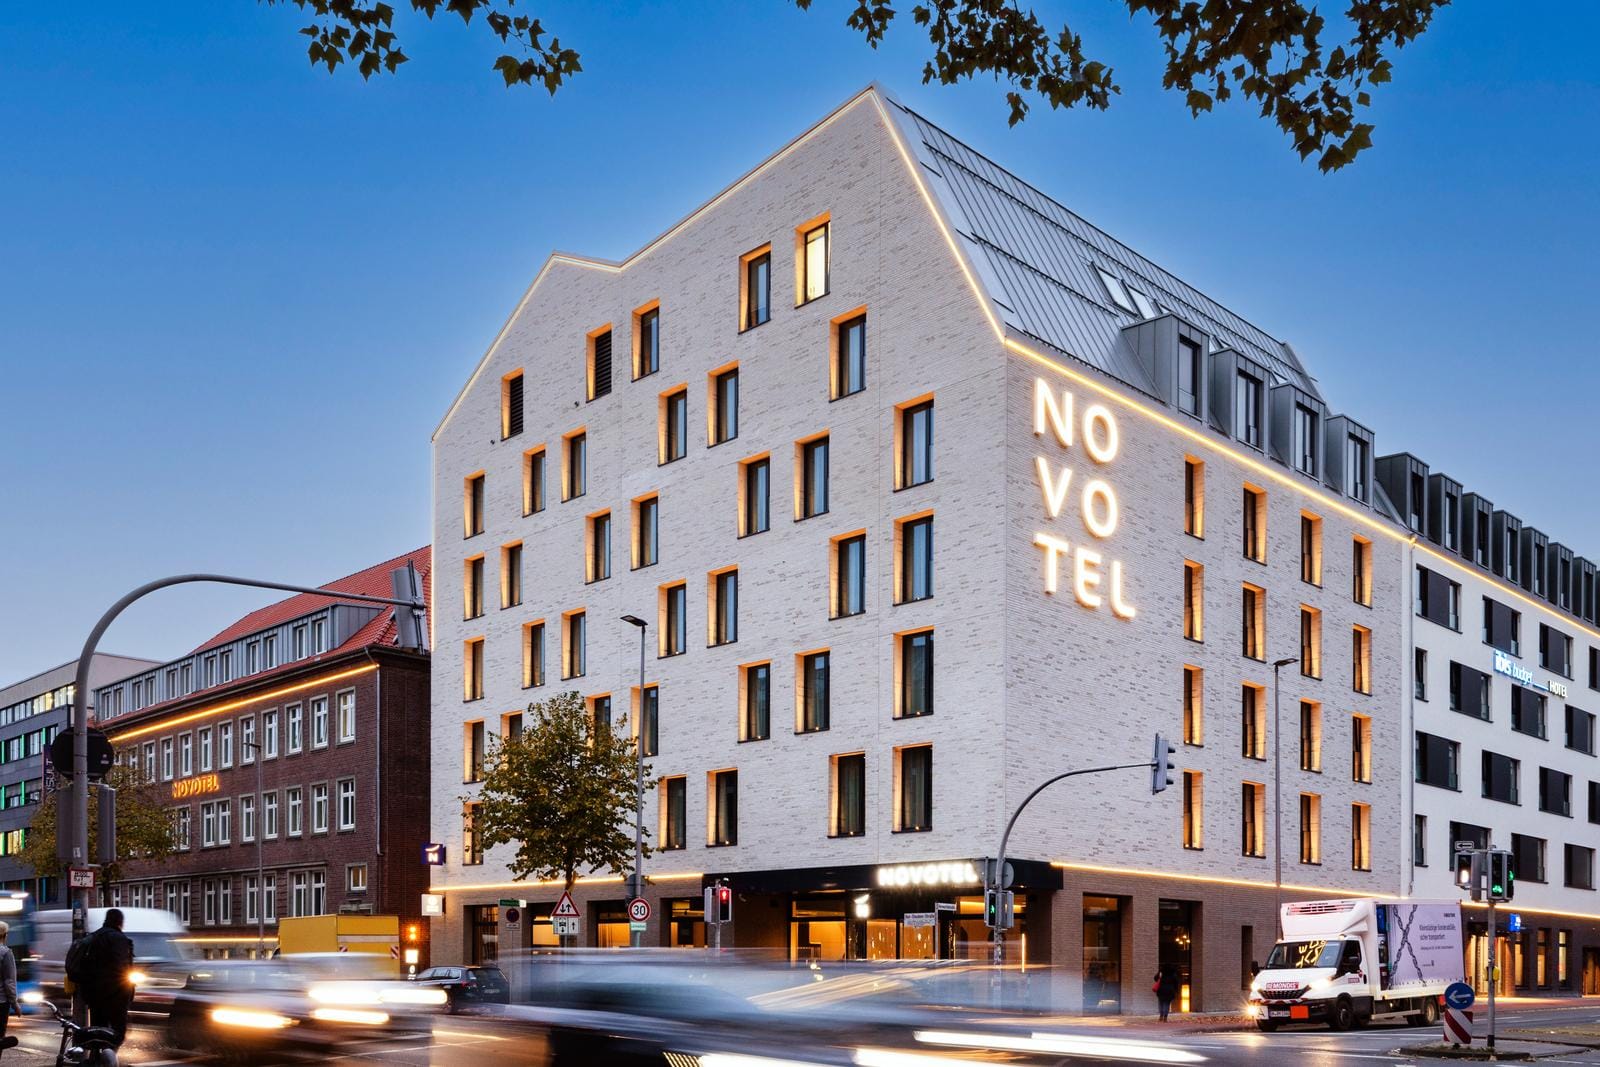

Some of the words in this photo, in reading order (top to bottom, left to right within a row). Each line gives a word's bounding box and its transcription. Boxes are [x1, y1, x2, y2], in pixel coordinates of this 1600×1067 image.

[1033, 532, 1136, 620] TEL
[1512, 662, 1533, 685] budget
[1548, 680, 1568, 698] HOTEL
[171, 774, 219, 799] NOVOTEL
[877, 861, 978, 887] NOVOTEL
[633, 905, 646, 916] 30
